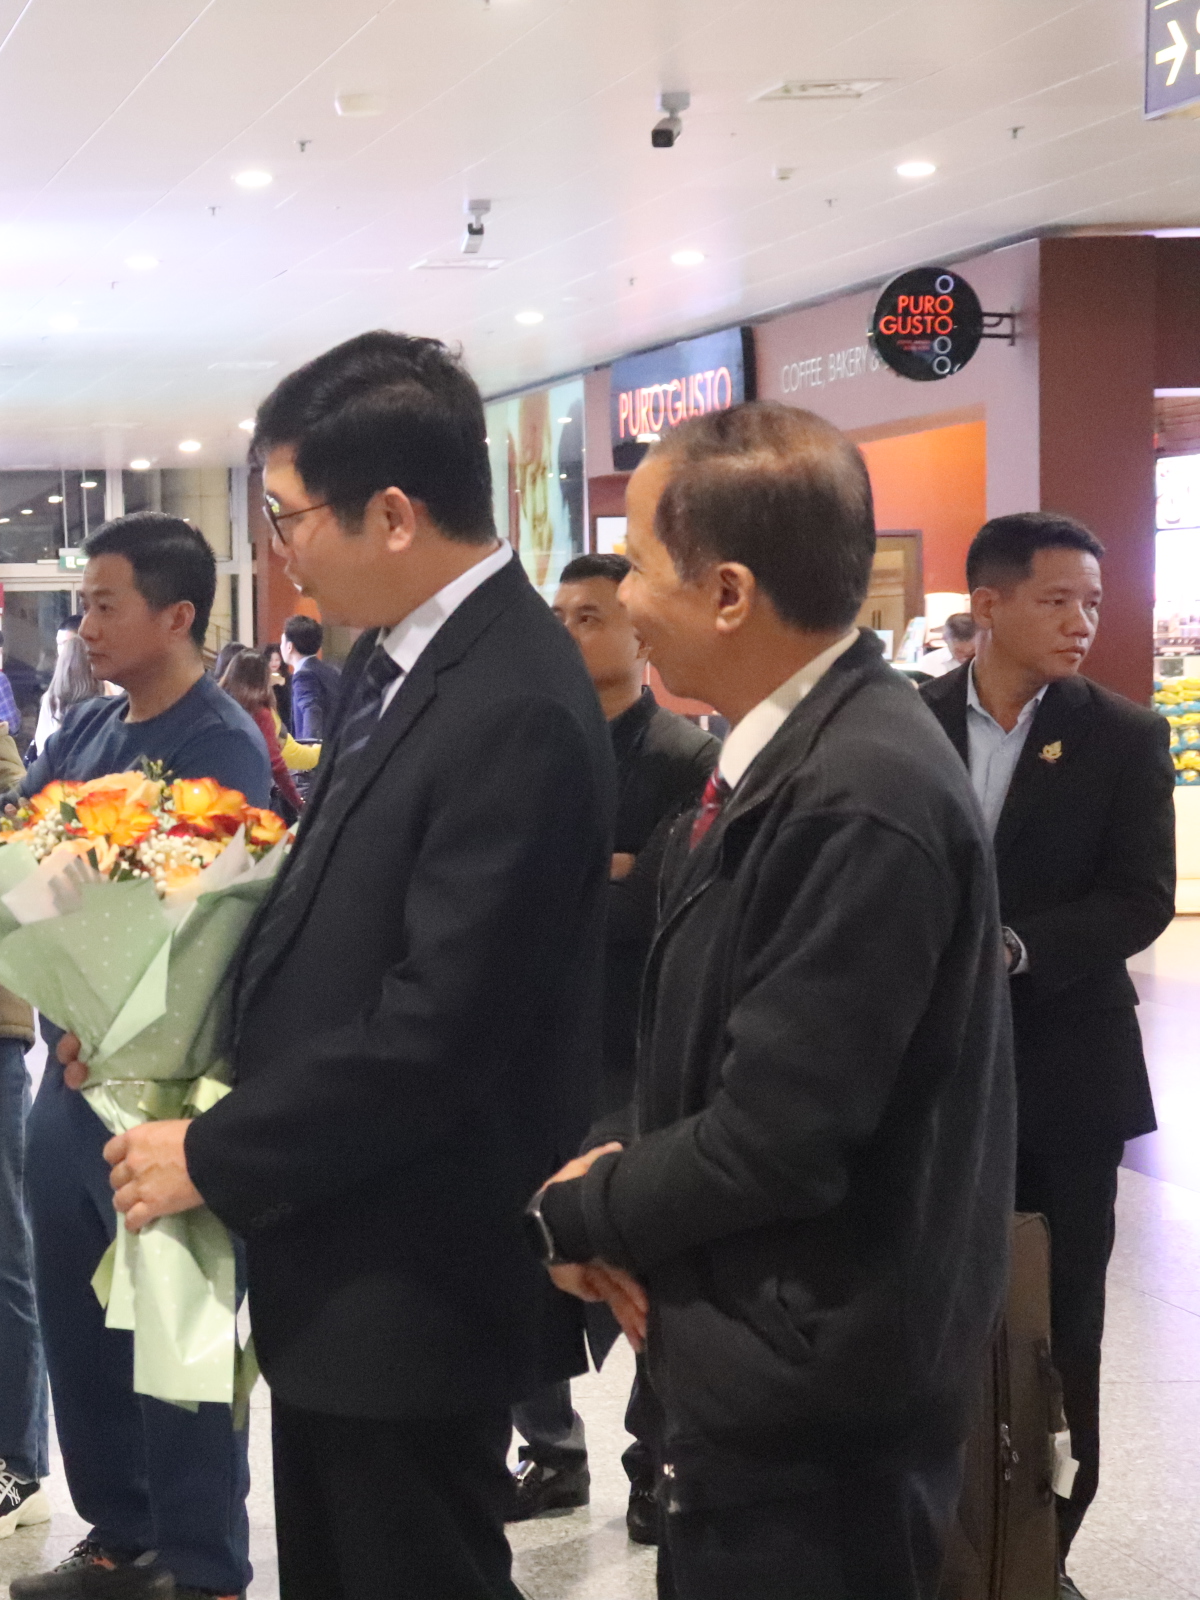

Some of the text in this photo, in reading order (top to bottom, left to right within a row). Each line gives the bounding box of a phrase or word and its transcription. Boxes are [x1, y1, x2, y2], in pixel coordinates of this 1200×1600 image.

[897, 295, 954, 314] PURO
[879, 315, 953, 335] GUSTO
[782, 356, 826, 394] COFFEE,
[829, 345, 869, 382] BAKERY
[619, 366, 732, 438] PURO GUSTO
